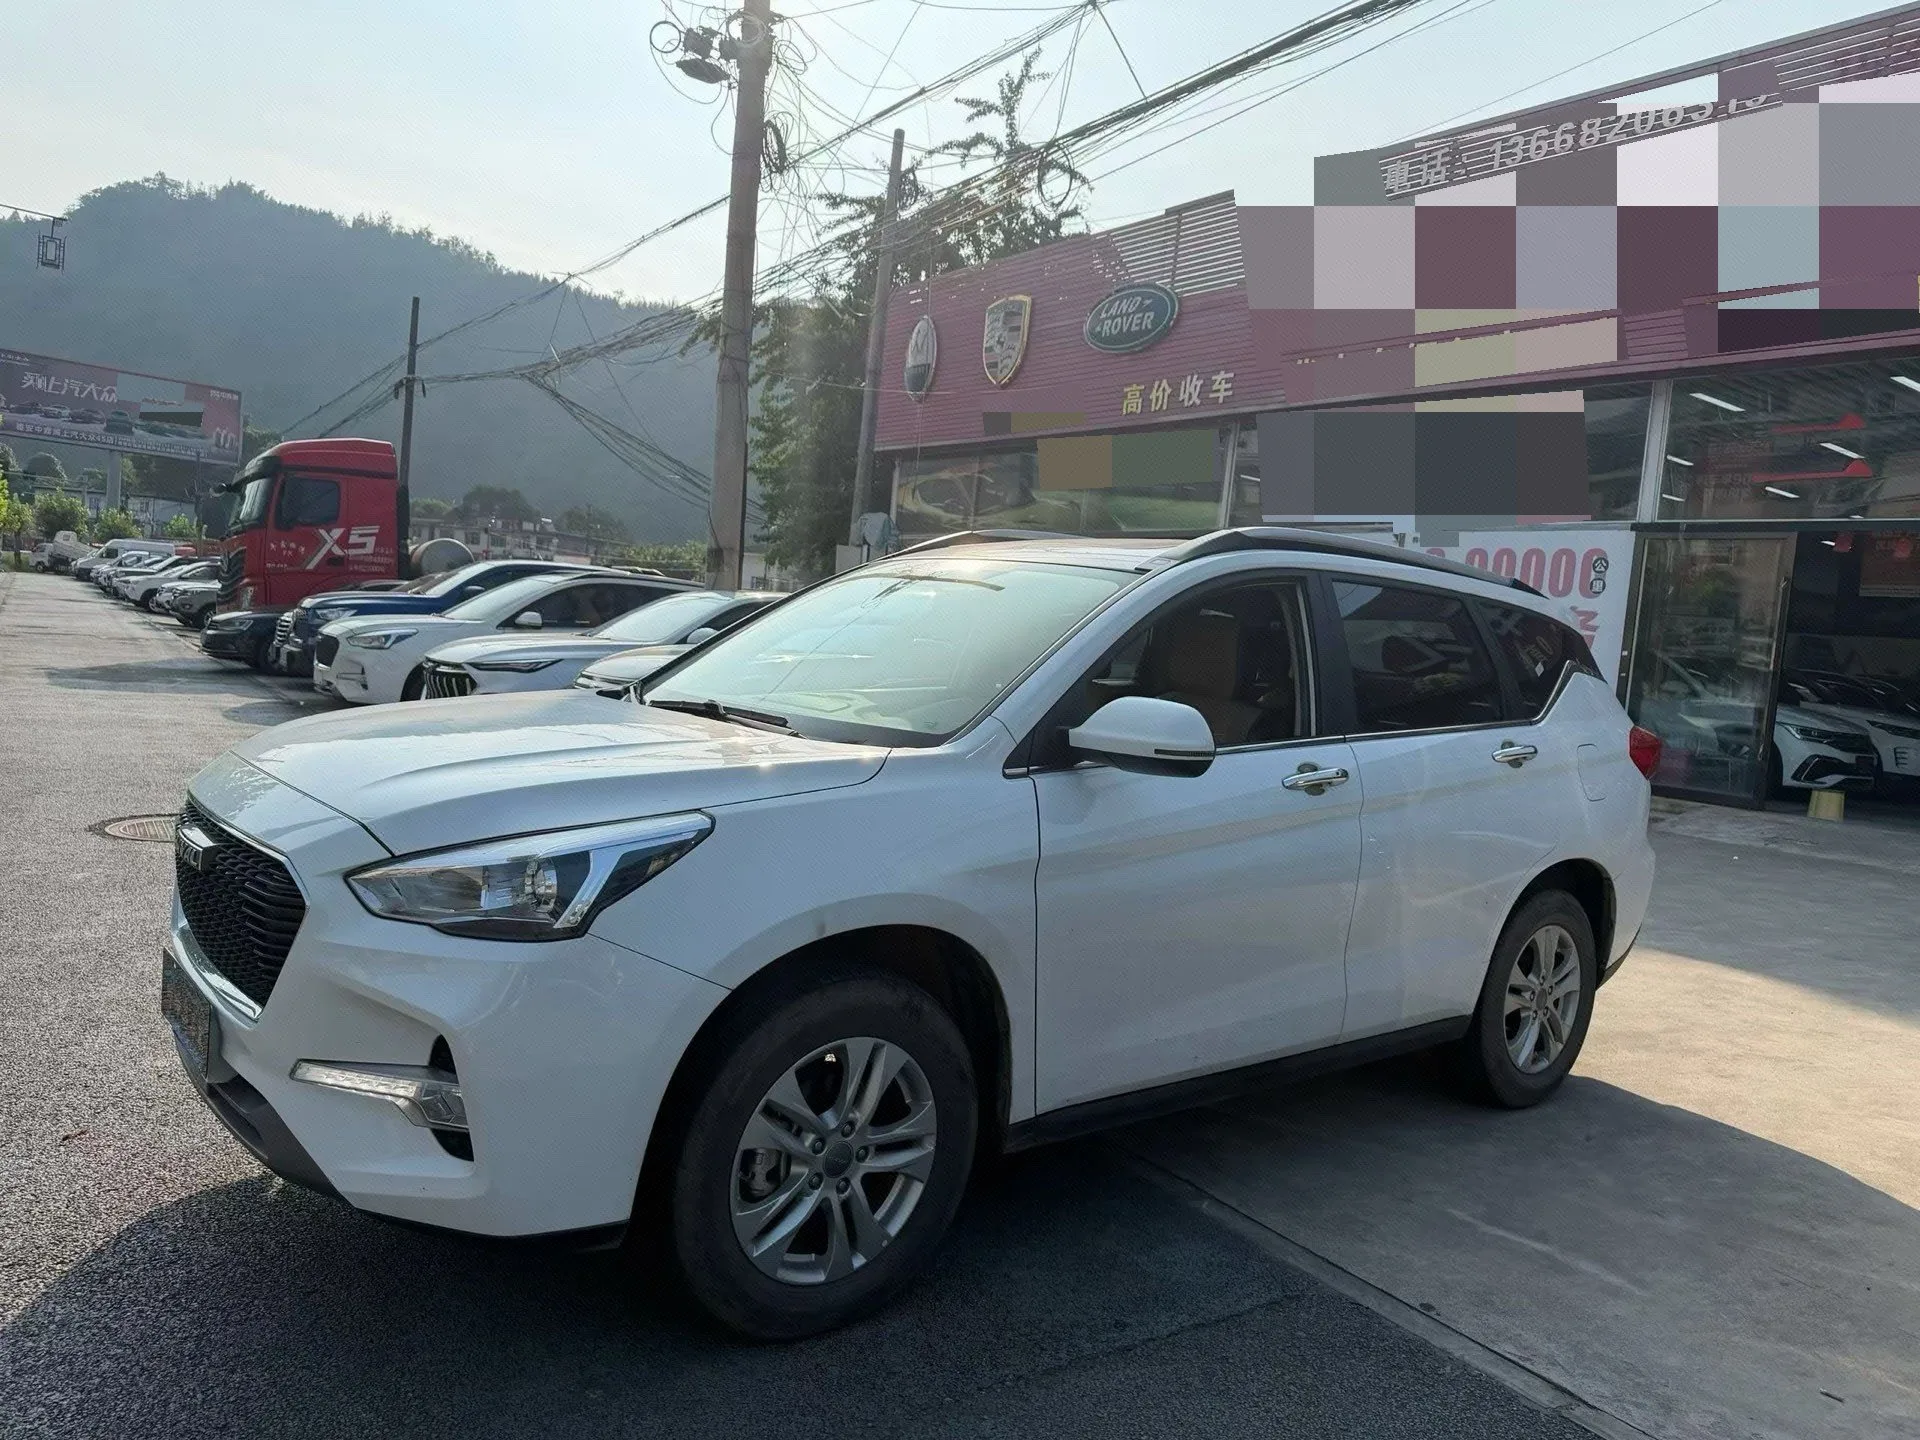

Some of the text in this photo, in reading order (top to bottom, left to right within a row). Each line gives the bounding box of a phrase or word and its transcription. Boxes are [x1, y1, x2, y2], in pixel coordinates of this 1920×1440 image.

[1100, 296, 1142, 319] LAND
[1102, 311, 1155, 338] ROVER
[1122, 370, 1235, 415] 高价收车
